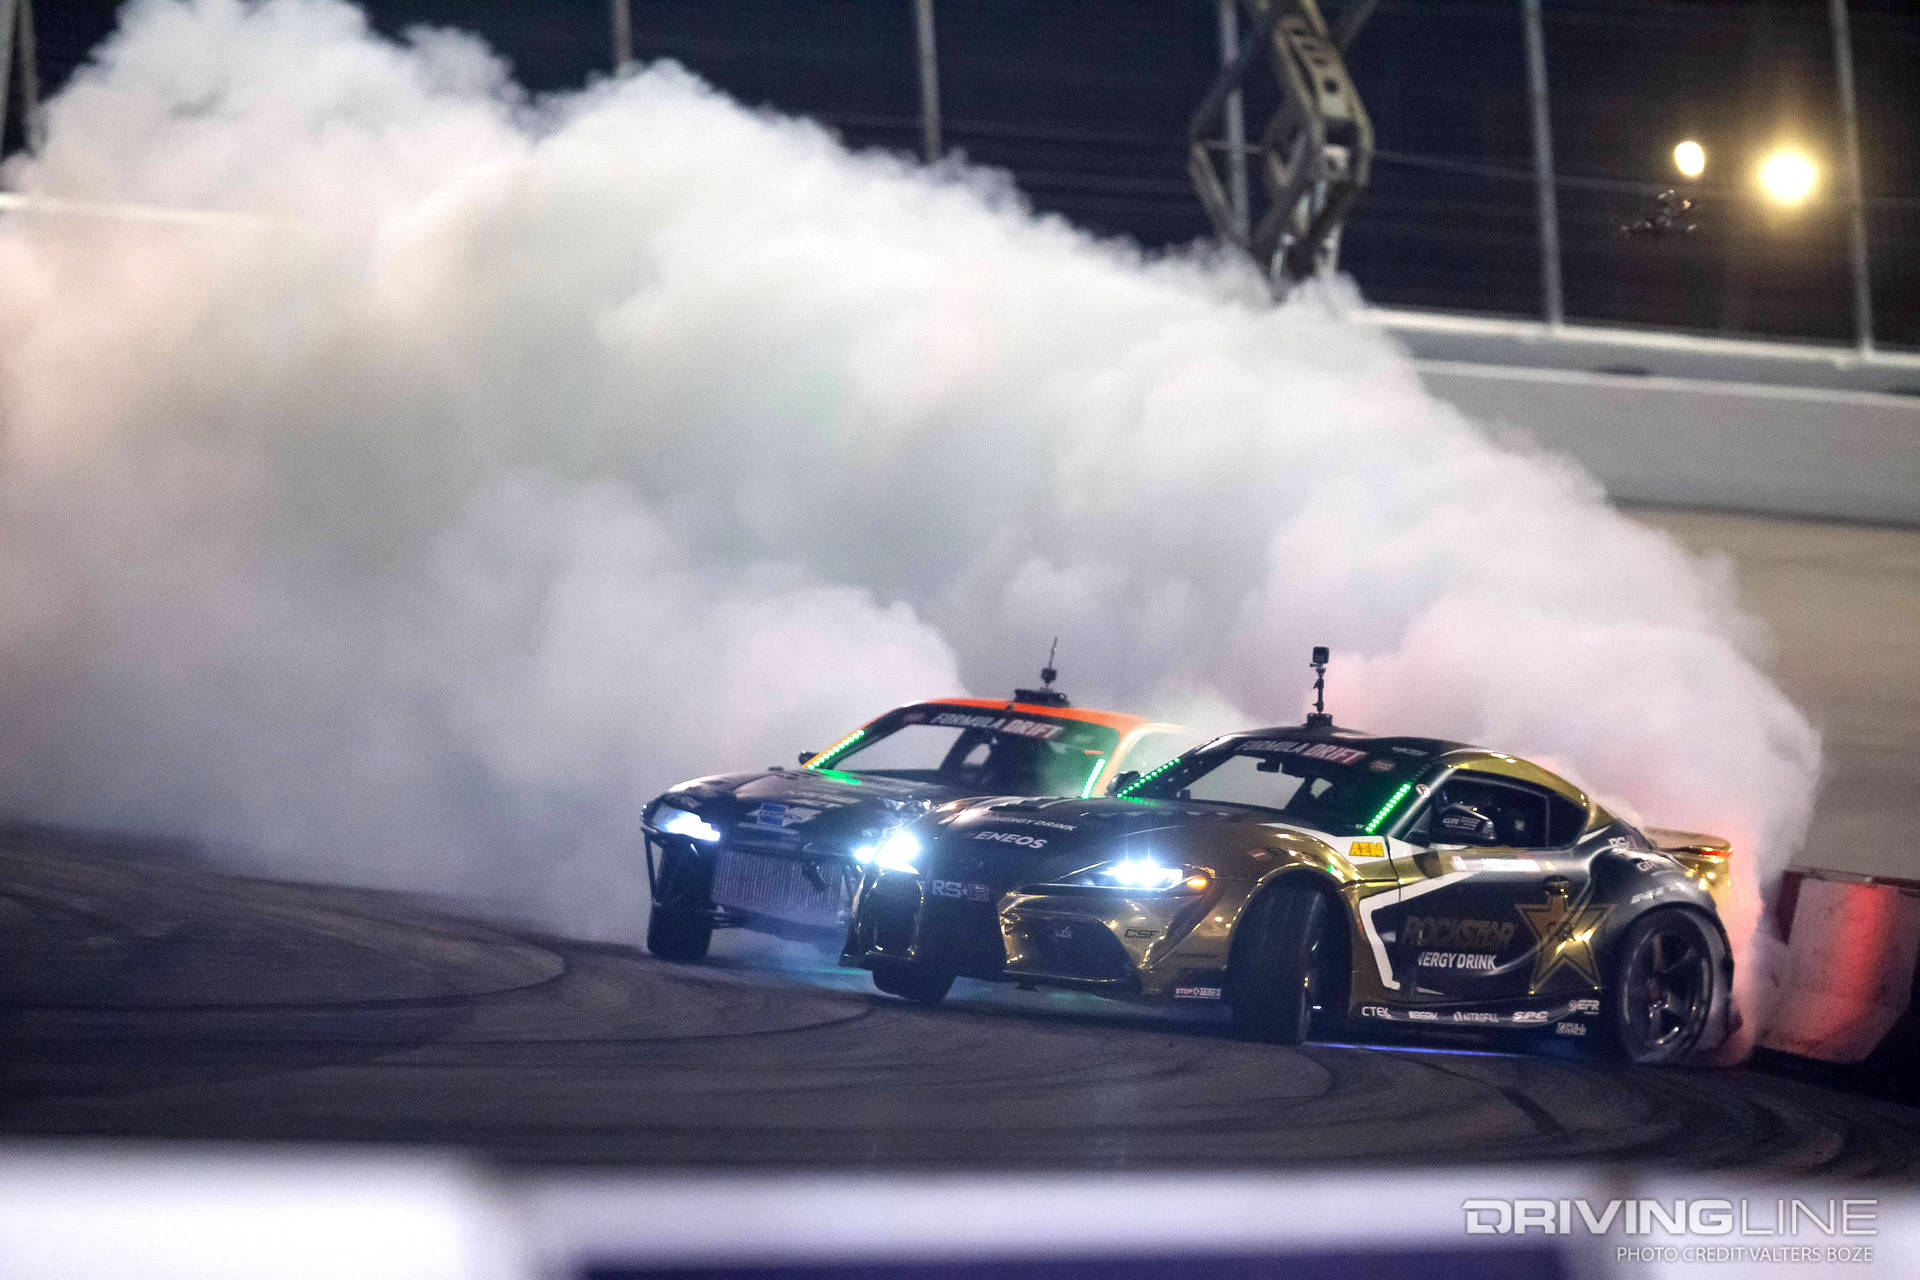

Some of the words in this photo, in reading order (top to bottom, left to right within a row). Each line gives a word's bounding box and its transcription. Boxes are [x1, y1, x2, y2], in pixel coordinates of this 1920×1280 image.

[1003, 718, 1063, 739] DRIFT
[1303, 743, 1368, 765] DRIFT
[1035, 819, 1078, 831] DRINK
[973, 831, 1048, 849] ENEOS
[1124, 928, 1159, 939] CSF
[1457, 953, 1497, 969] DRINK
[1361, 1006, 1392, 1019] CTEK
